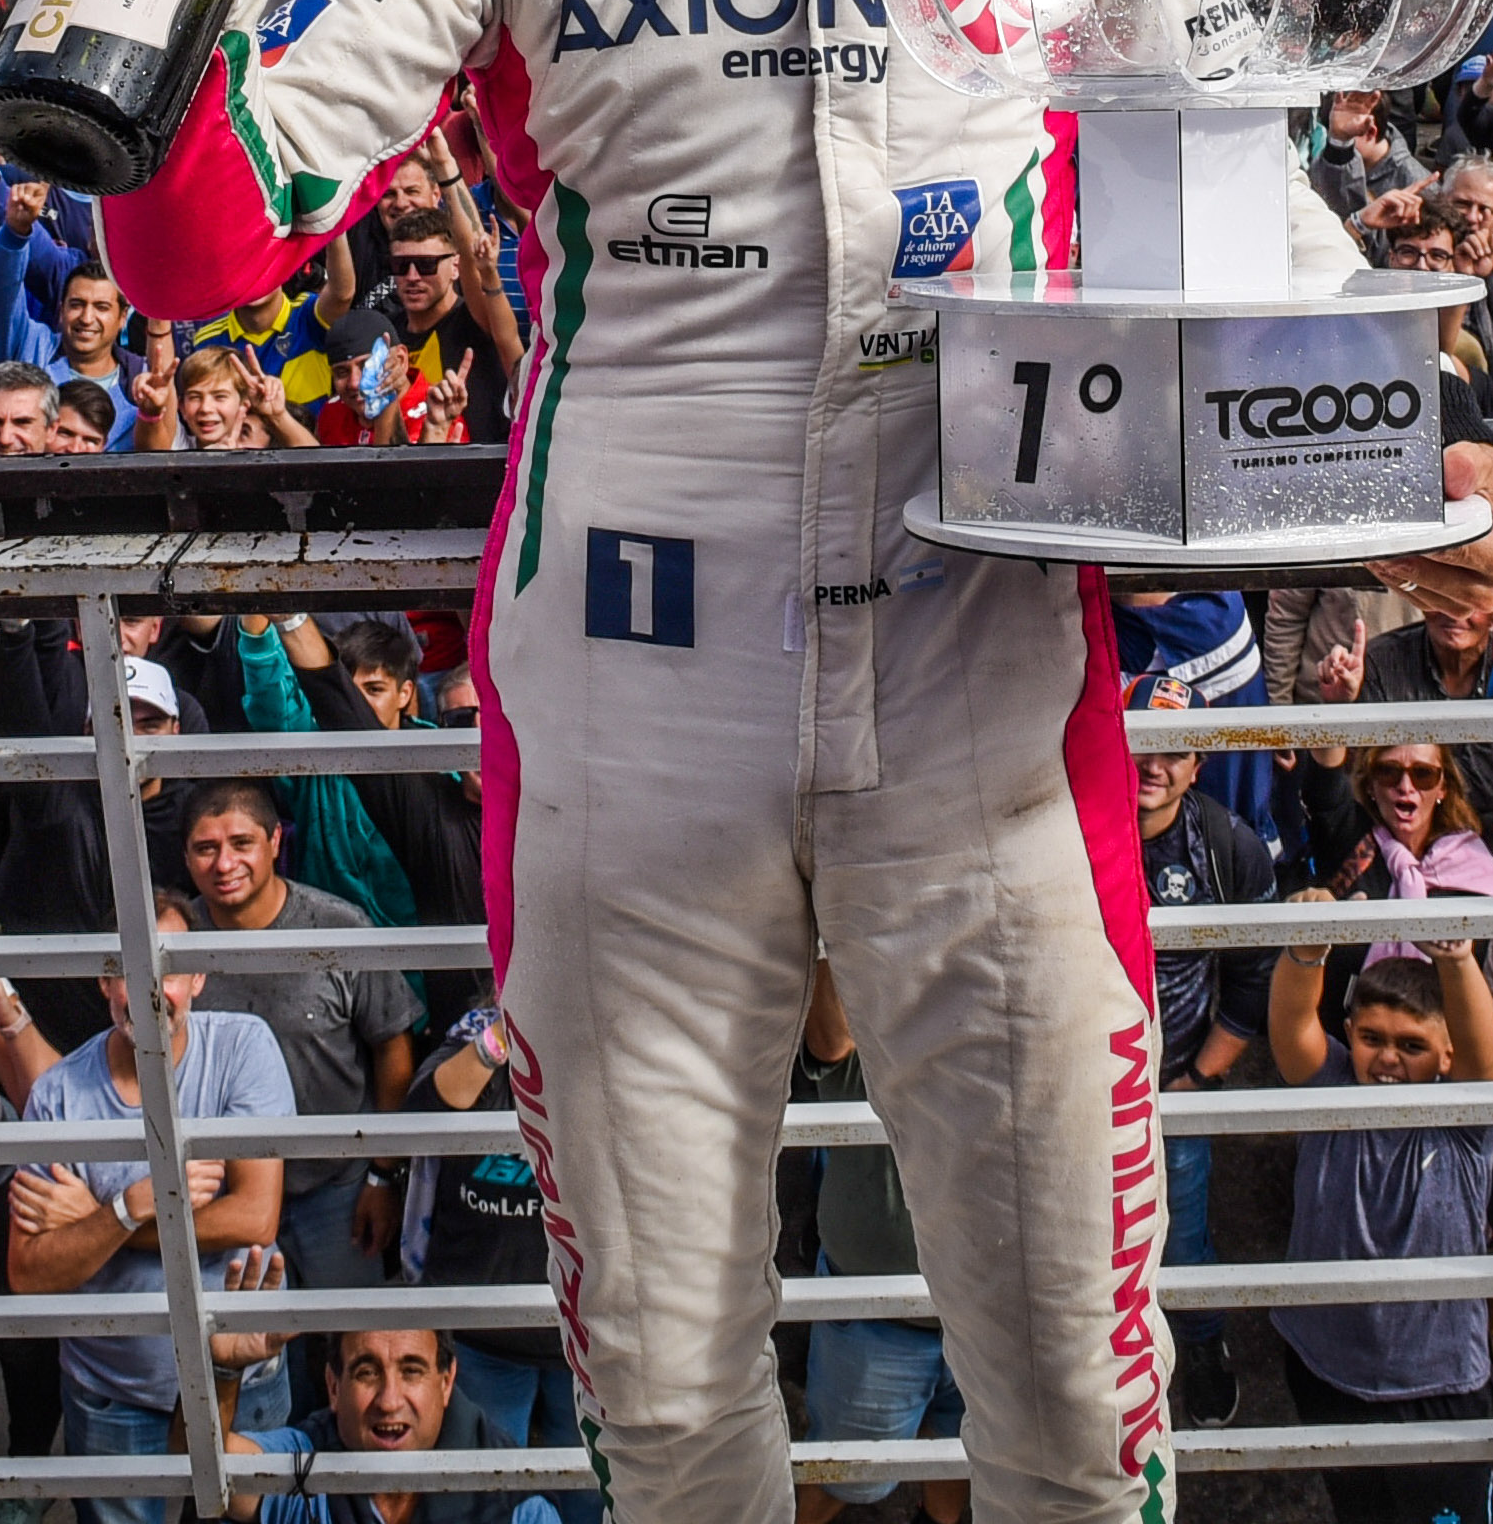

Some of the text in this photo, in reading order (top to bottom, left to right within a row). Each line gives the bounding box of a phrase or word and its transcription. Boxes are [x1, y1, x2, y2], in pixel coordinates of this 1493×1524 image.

[722, 41, 888, 85] energy
[922, 190, 956, 214] LA
[909, 212, 970, 242] CAJA
[607, 239, 769, 269] etman
[904, 239, 956, 253] de ahorro
[910, 253, 946, 267] seguro
[859, 328, 938, 357] VENTU
[1205, 379, 1422, 440] TC2000
[1232, 445, 1404, 470] TURISMO COMPETICIÓN
[618, 538, 655, 636] 1
[814, 578, 893, 606] PERNA
[1109, 1021, 1165, 1477] QUANTIUM
